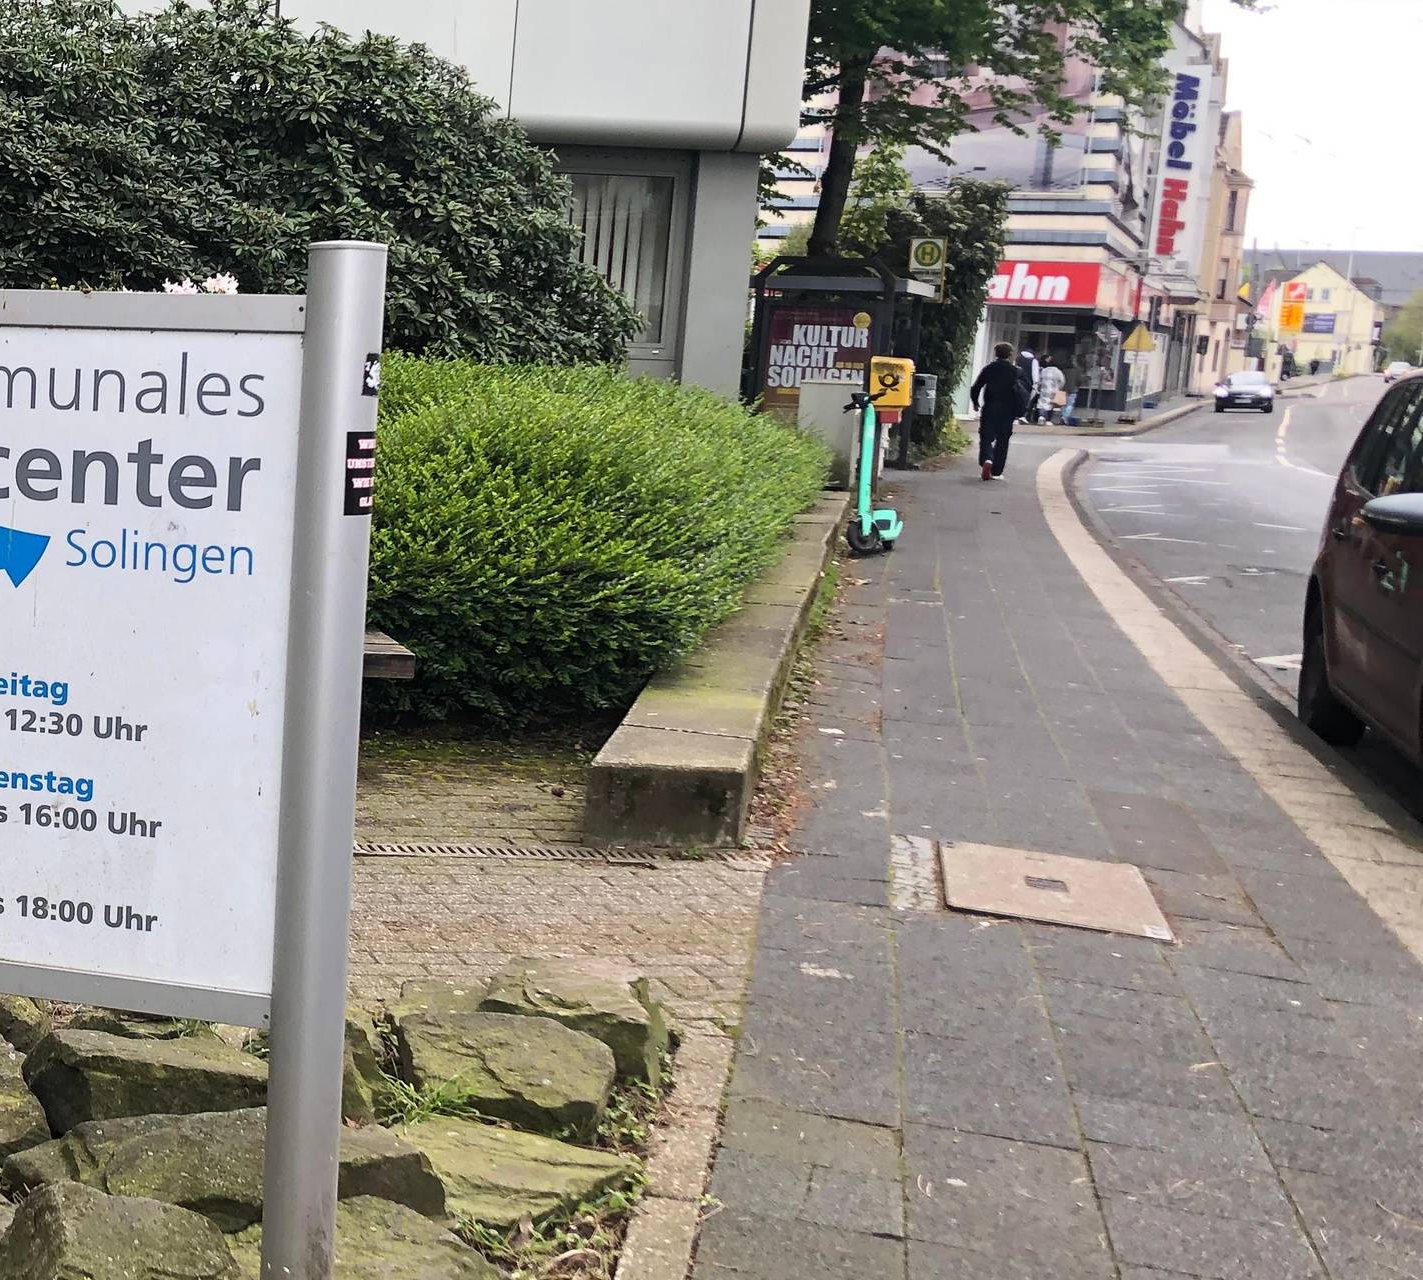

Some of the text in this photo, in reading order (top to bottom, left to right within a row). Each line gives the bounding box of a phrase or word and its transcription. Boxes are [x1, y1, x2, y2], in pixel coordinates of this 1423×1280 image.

[1156, 73, 1200, 256] Möbel Hahn
[988, 263, 1070, 301] ahn
[792, 324, 869, 348] KULTUR
[769, 344, 838, 368] NACHT
[65, 527, 254, 584] Solingen
[4, 708, 83, 737] 12:30
[93, 715, 148, 742] Uhr
[18, 802, 98, 832] 16:00
[107, 811, 163, 839] Uhr
[15, 894, 94, 925] 18:00
[103, 904, 159, 932] Uhr
